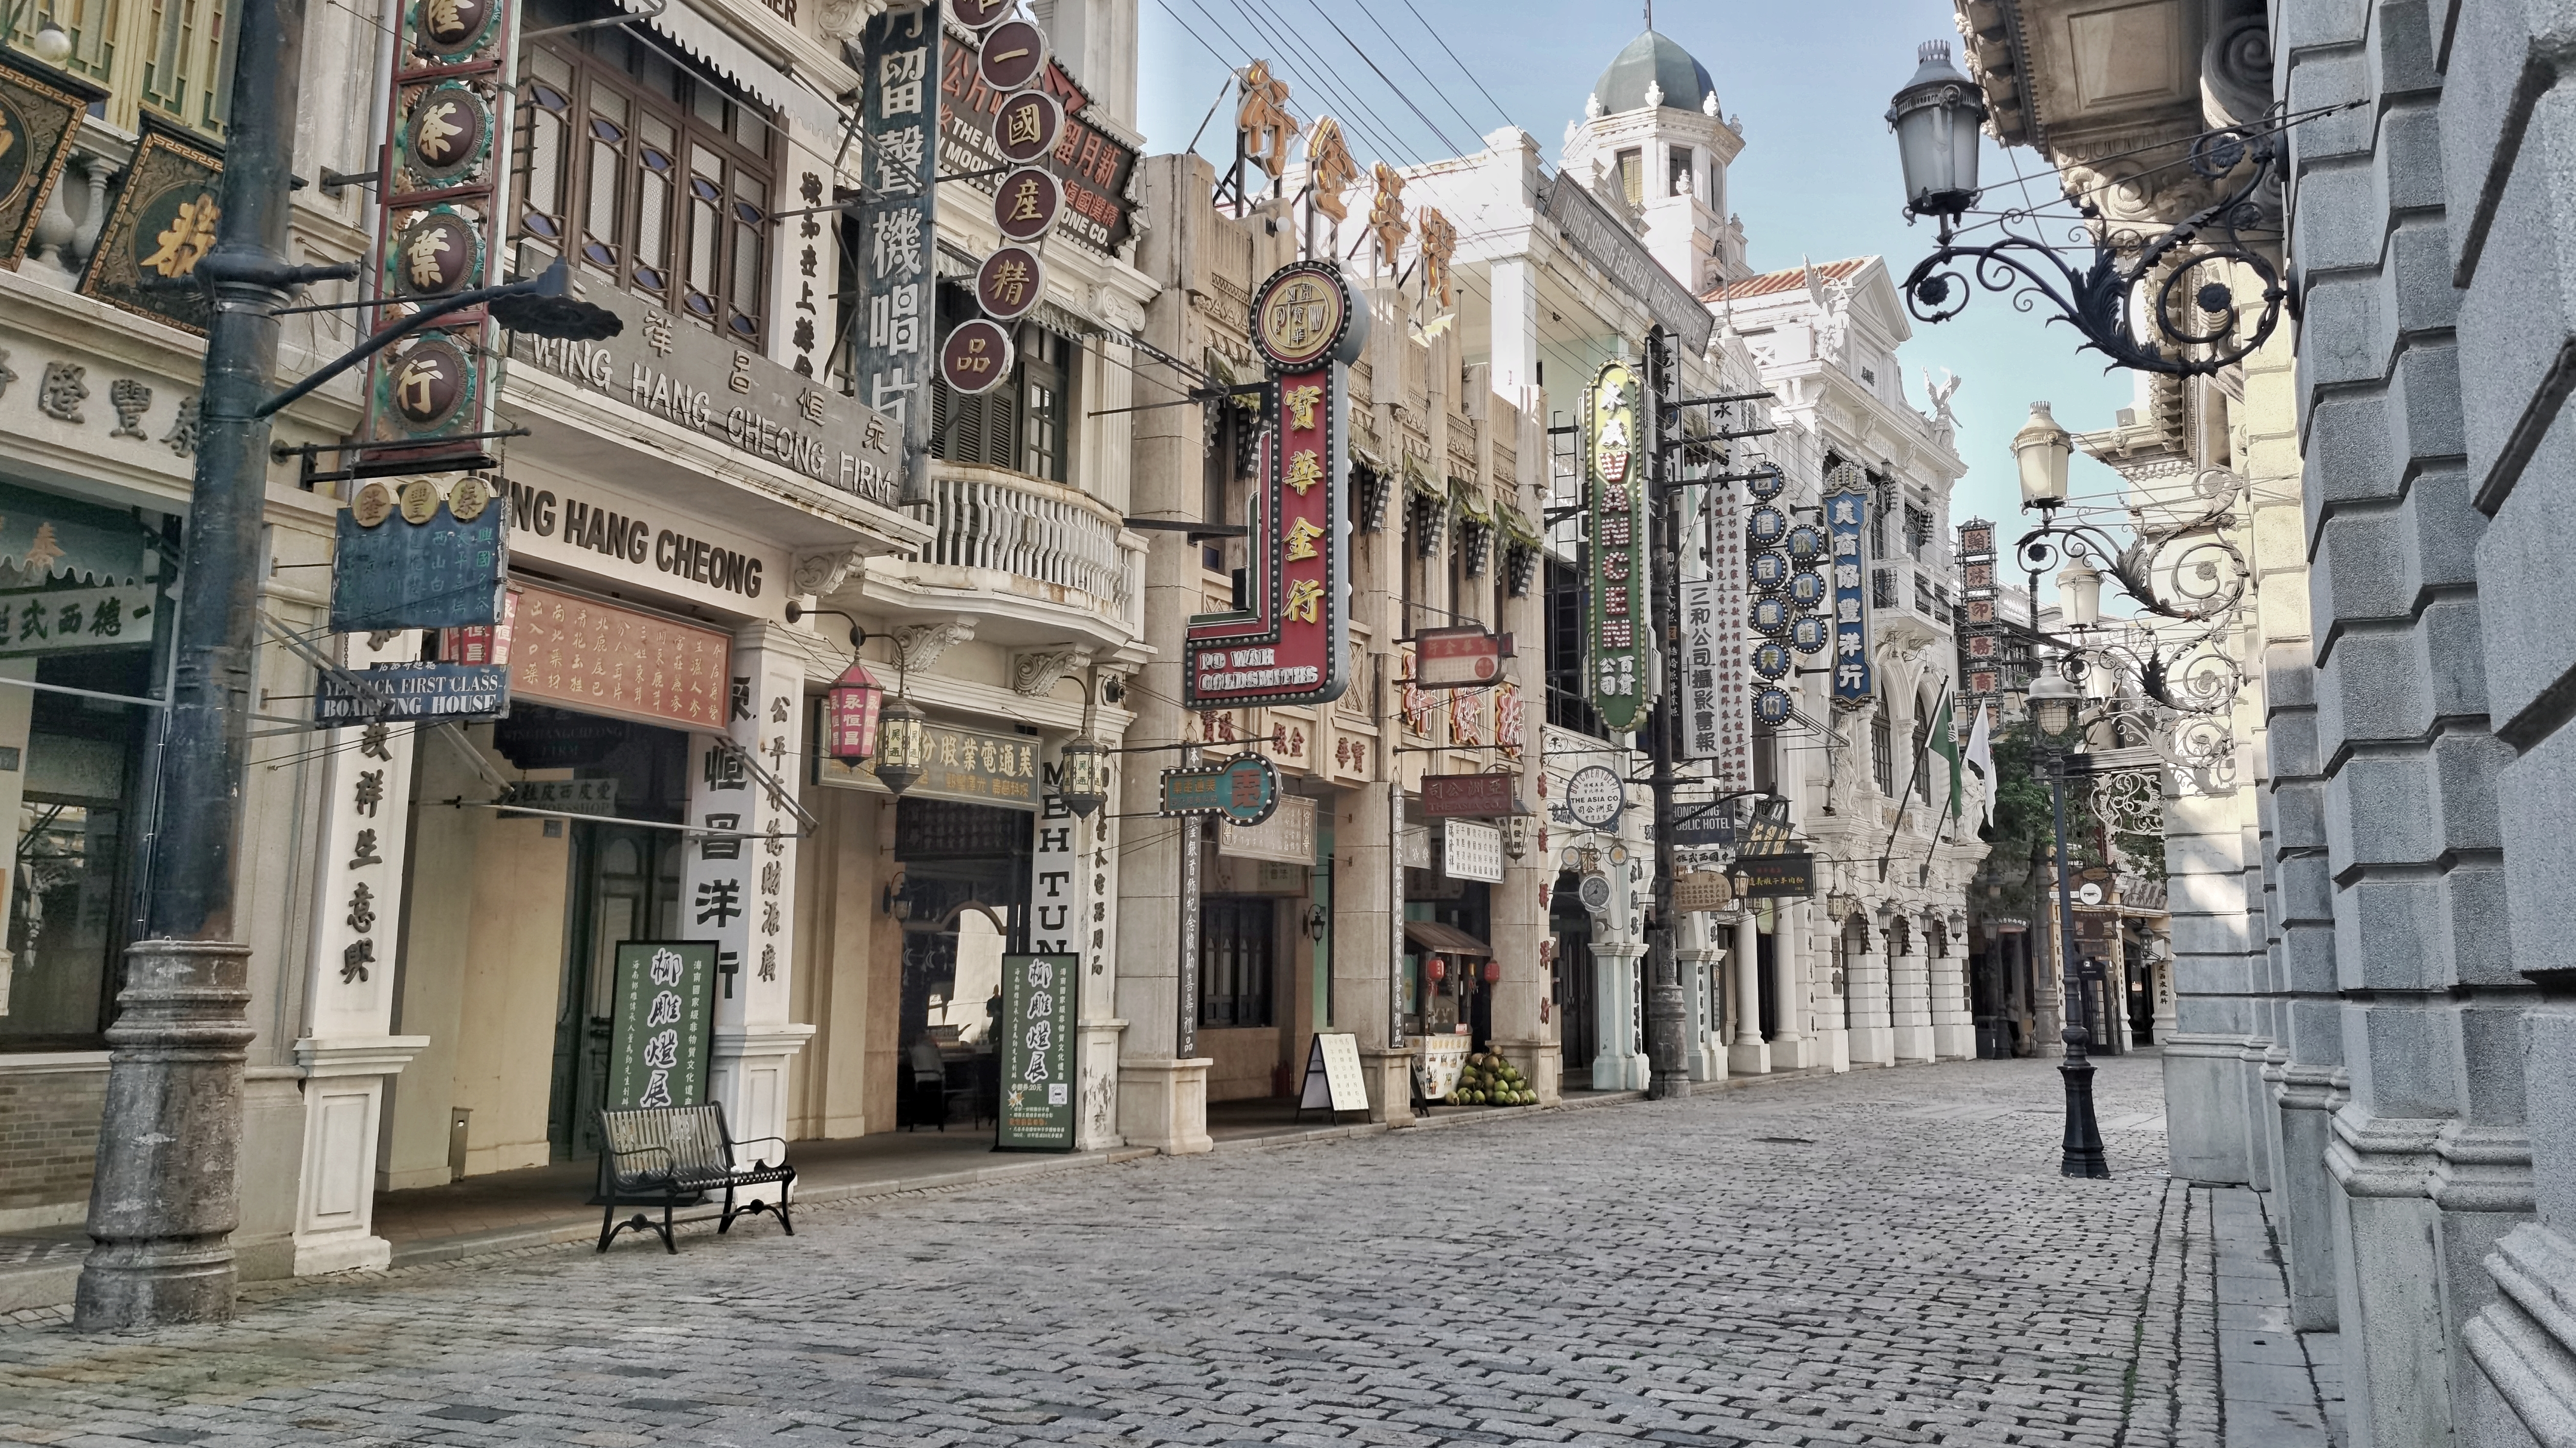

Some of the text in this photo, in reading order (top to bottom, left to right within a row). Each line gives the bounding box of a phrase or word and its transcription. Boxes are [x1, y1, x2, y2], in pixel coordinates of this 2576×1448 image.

[953, 117, 982, 146] THE
[957, 0, 1042, 374] 一國產精品
[1089, 224, 1109, 247] CO.
[1562, 189, 1592, 242] WING
[1588, 222, 1618, 269] SHING
[1614, 248, 1653, 303] GENERAL
[632, 362, 710, 432] HANG
[726, 407, 825, 477] CHEONG
[839, 451, 891, 504] FIRM
[1282, 385, 1325, 624] 寶華金行
[563, 498, 649, 565] HANG
[655, 528, 762, 599] CHEONG
[1598, 452, 1634, 648] VANCEN
[523, 600, 545, 685] 出入口藥
[1200, 648, 1275, 670] PO WAH
[400, 676, 447, 694] FIRST
[431, 693, 497, 714] HOUSE
[1199, 665, 1319, 691] GOLDSMITHS
[843, 694, 864, 745] 永恒昌
[1578, 803, 1615, 814] 亞洲公司
[1673, 818, 1731, 831] UBLIC HOTEL
[640, 947, 683, 1108] 椰雕燈展
[1025, 958, 1052, 1083] 椰雕燈展
